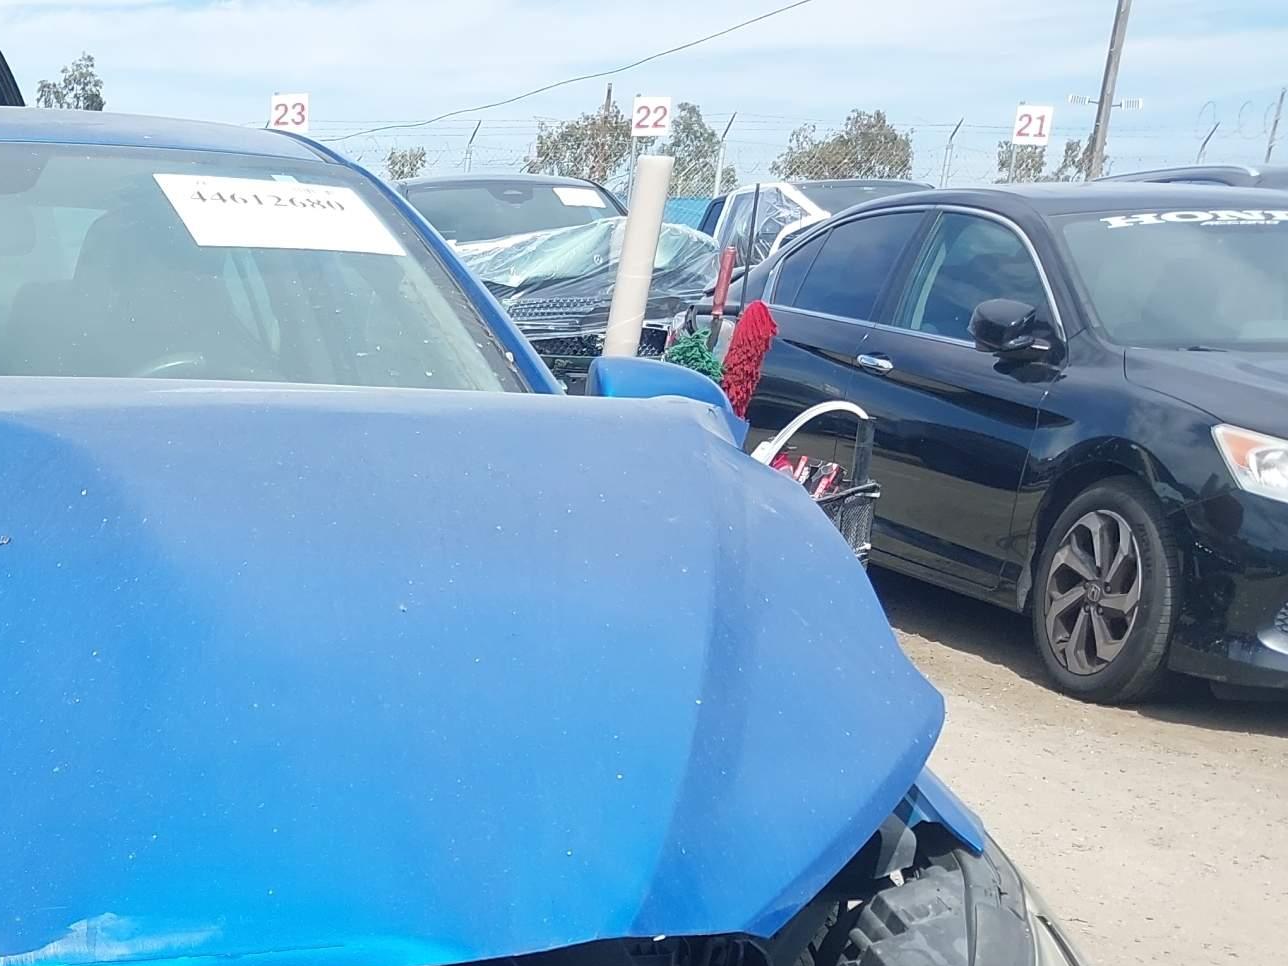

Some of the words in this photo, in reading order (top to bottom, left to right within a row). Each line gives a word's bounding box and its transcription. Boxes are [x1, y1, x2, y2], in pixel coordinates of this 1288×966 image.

[273, 102, 305, 126] 23
[634, 105, 668, 129] 22
[1015, 113, 1047, 138] 21
[190, 190, 346, 212] 44612680
